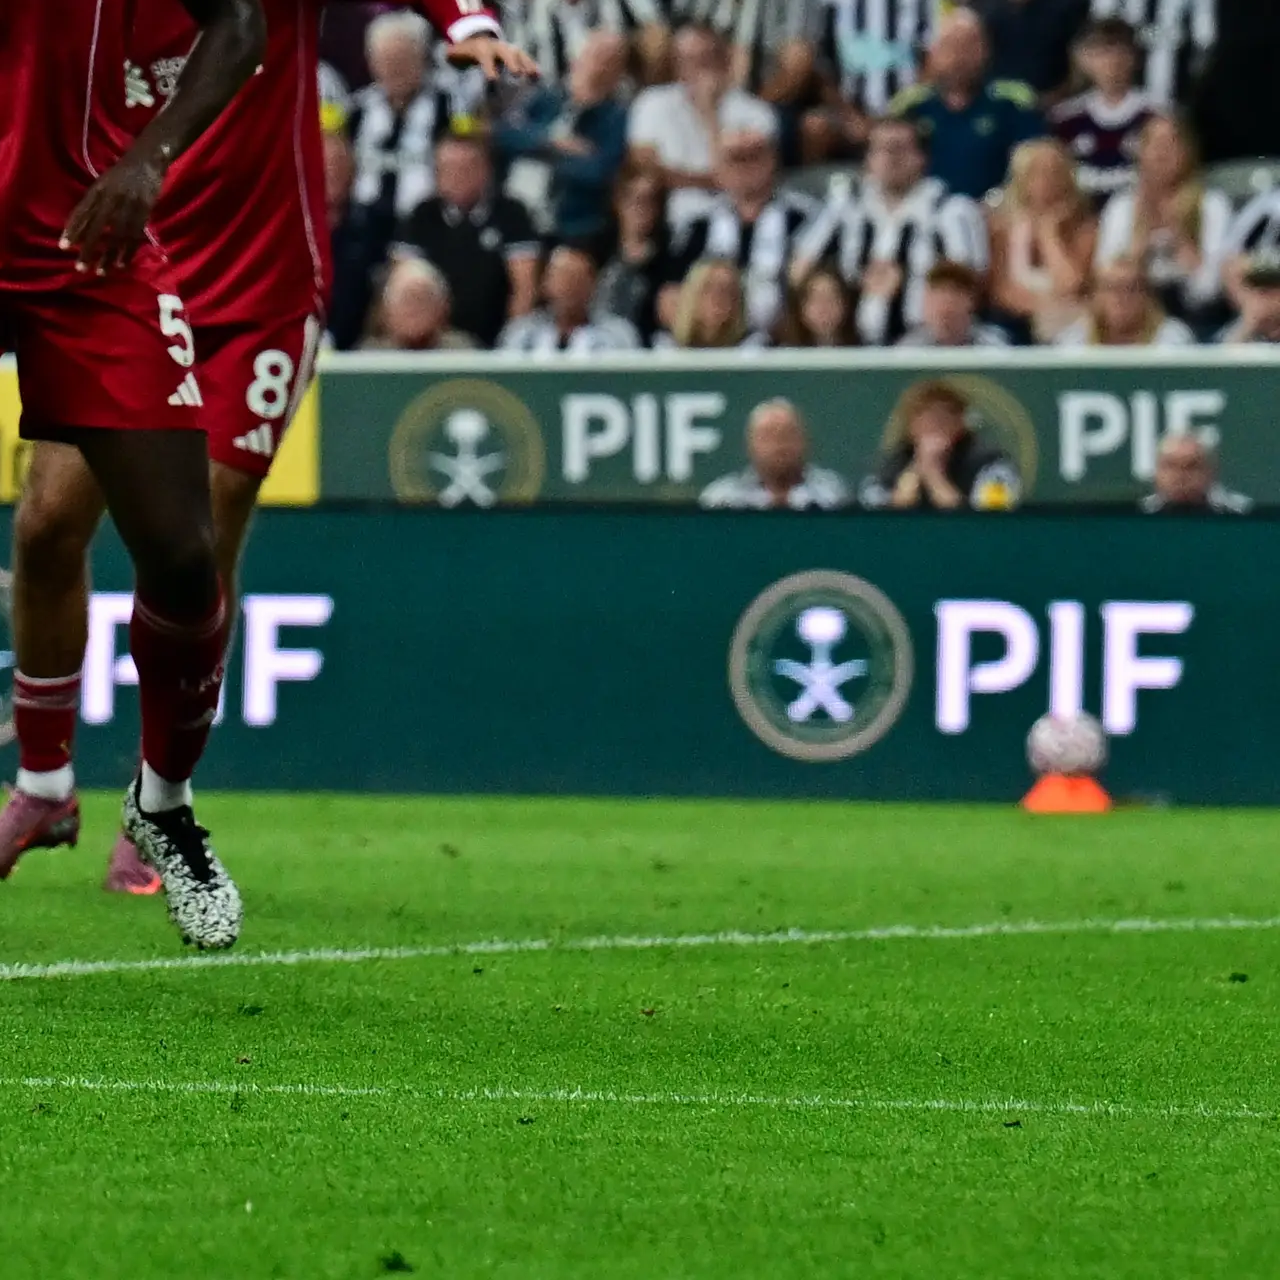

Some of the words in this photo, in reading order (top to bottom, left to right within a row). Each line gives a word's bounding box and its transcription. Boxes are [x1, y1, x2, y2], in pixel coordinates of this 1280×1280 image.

[157, 293, 195, 367] 5
[246, 349, 294, 419] 8
[560, 392, 727, 484] PIF
[1057, 389, 1227, 483] PIF
[80, 591, 335, 727] PF
[933, 598, 1195, 736] PIF
